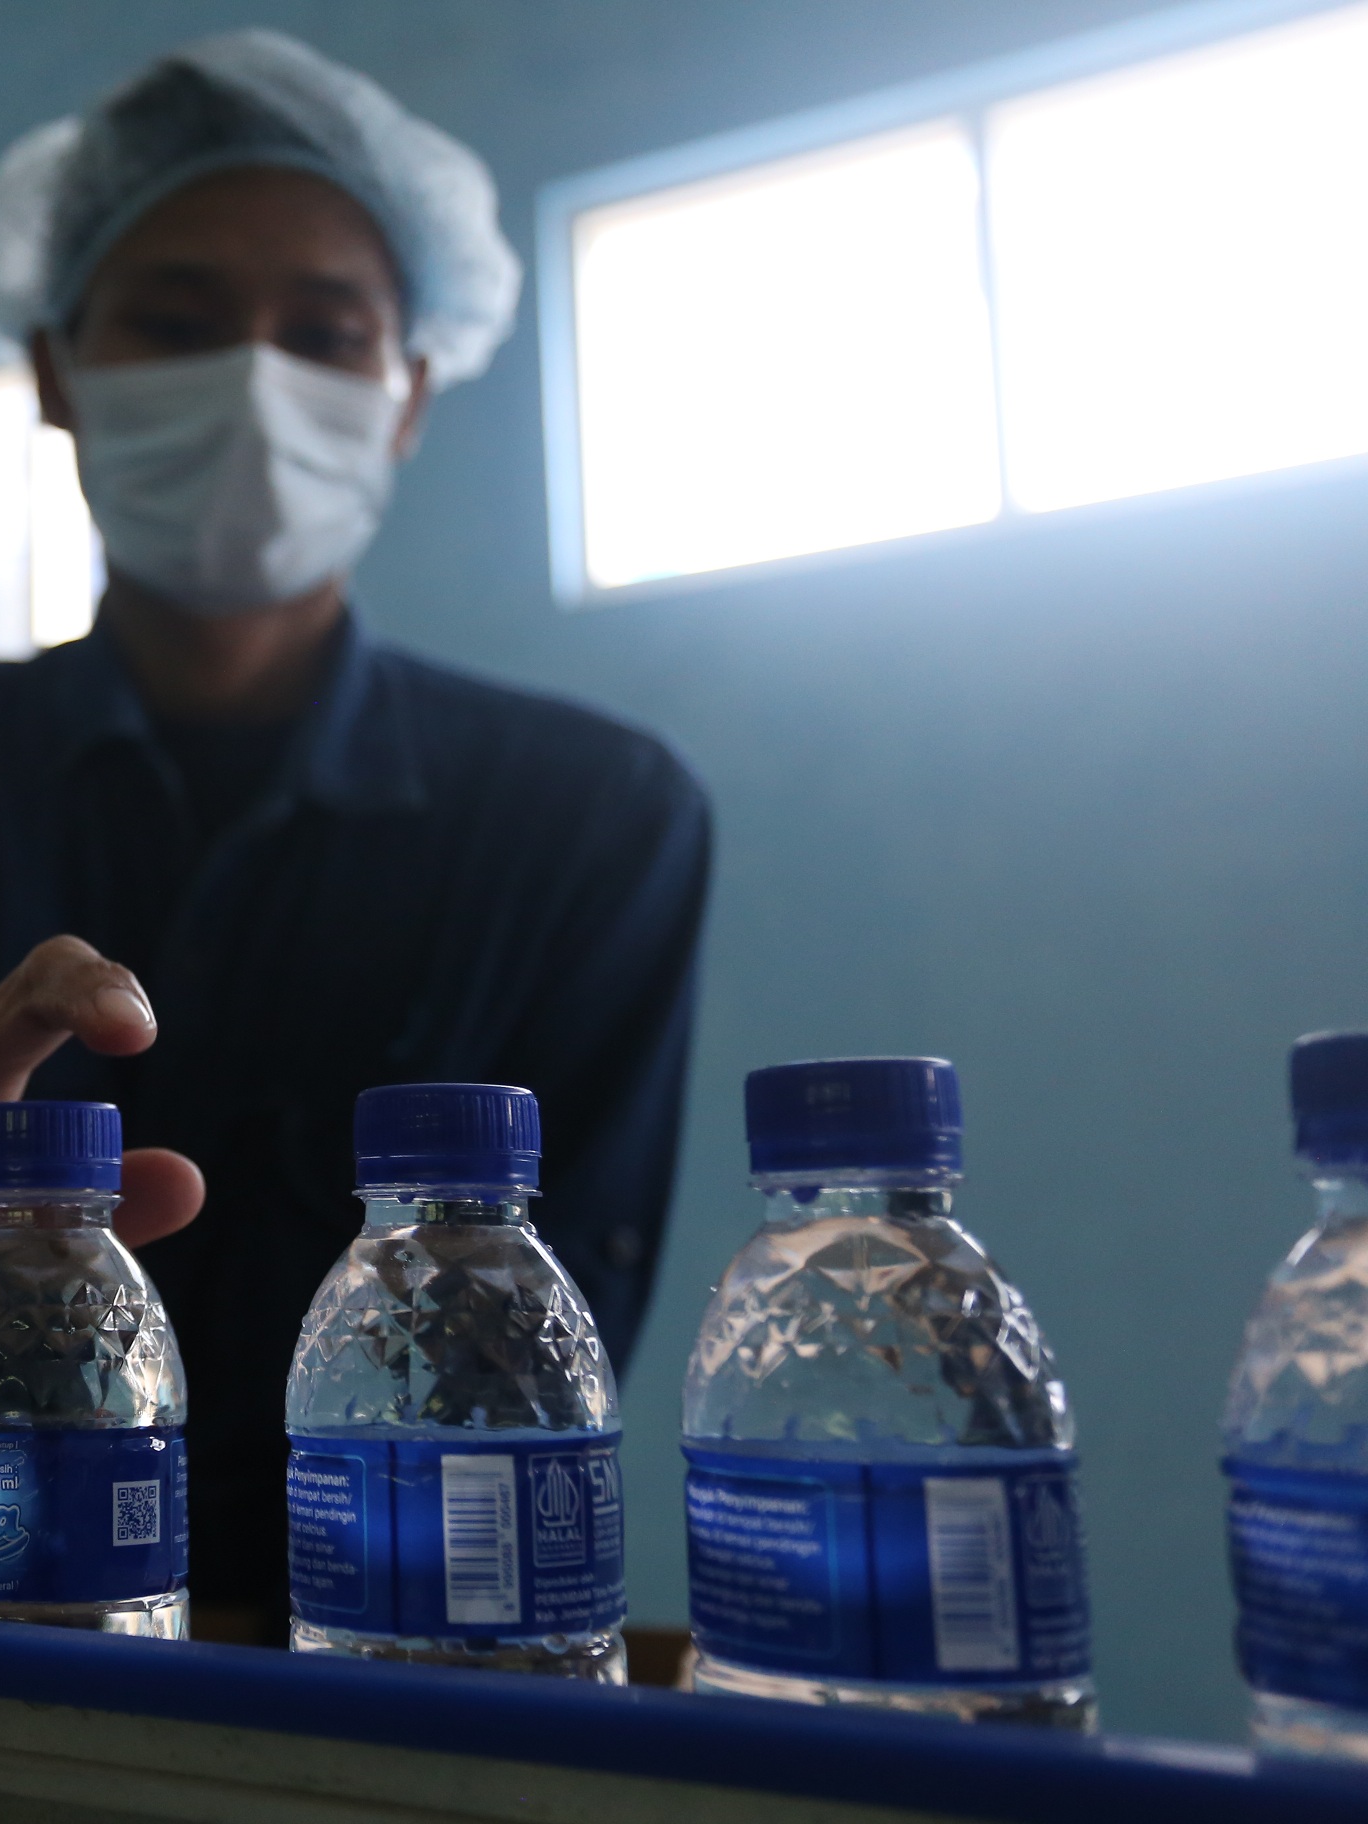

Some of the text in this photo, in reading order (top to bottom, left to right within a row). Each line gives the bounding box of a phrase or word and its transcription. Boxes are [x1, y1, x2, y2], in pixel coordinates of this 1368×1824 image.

[1, 1476, 19, 1490] ml
[314, 1509, 357, 1525] pendingin
[537, 1527, 582, 1543] HALAL
